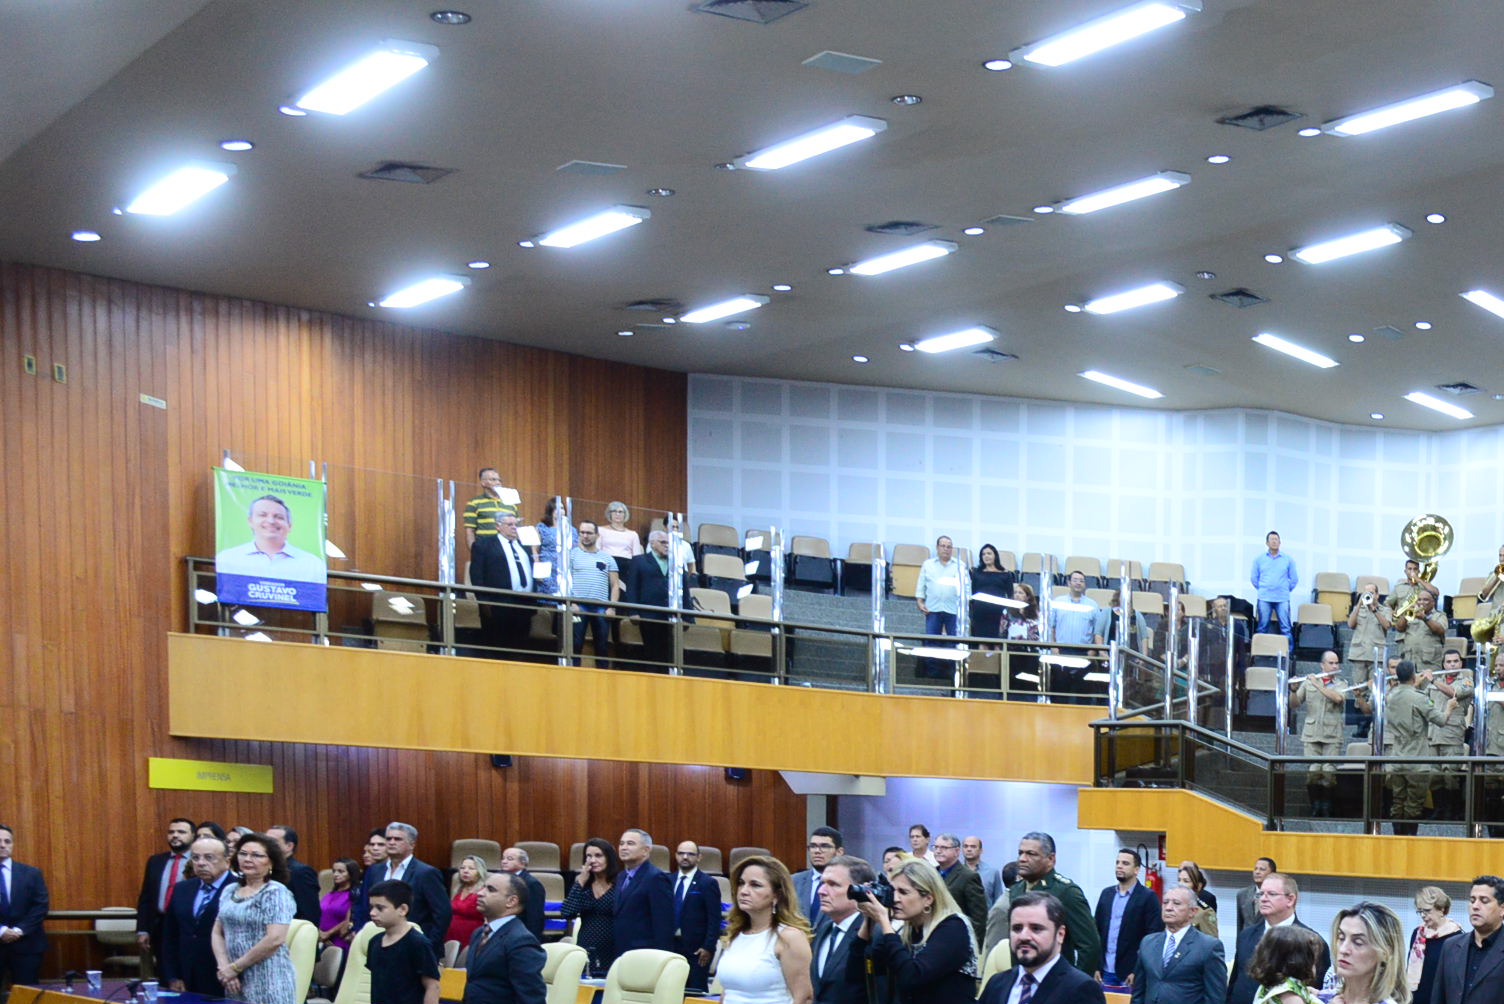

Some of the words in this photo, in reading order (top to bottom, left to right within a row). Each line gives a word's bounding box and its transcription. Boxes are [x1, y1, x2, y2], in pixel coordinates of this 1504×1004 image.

[252, 477, 270, 485] UMA
[288, 489, 312, 497] VERDE
[248, 583, 297, 595] GUSTAVO
[248, 591, 297, 602] CRUVINEL
